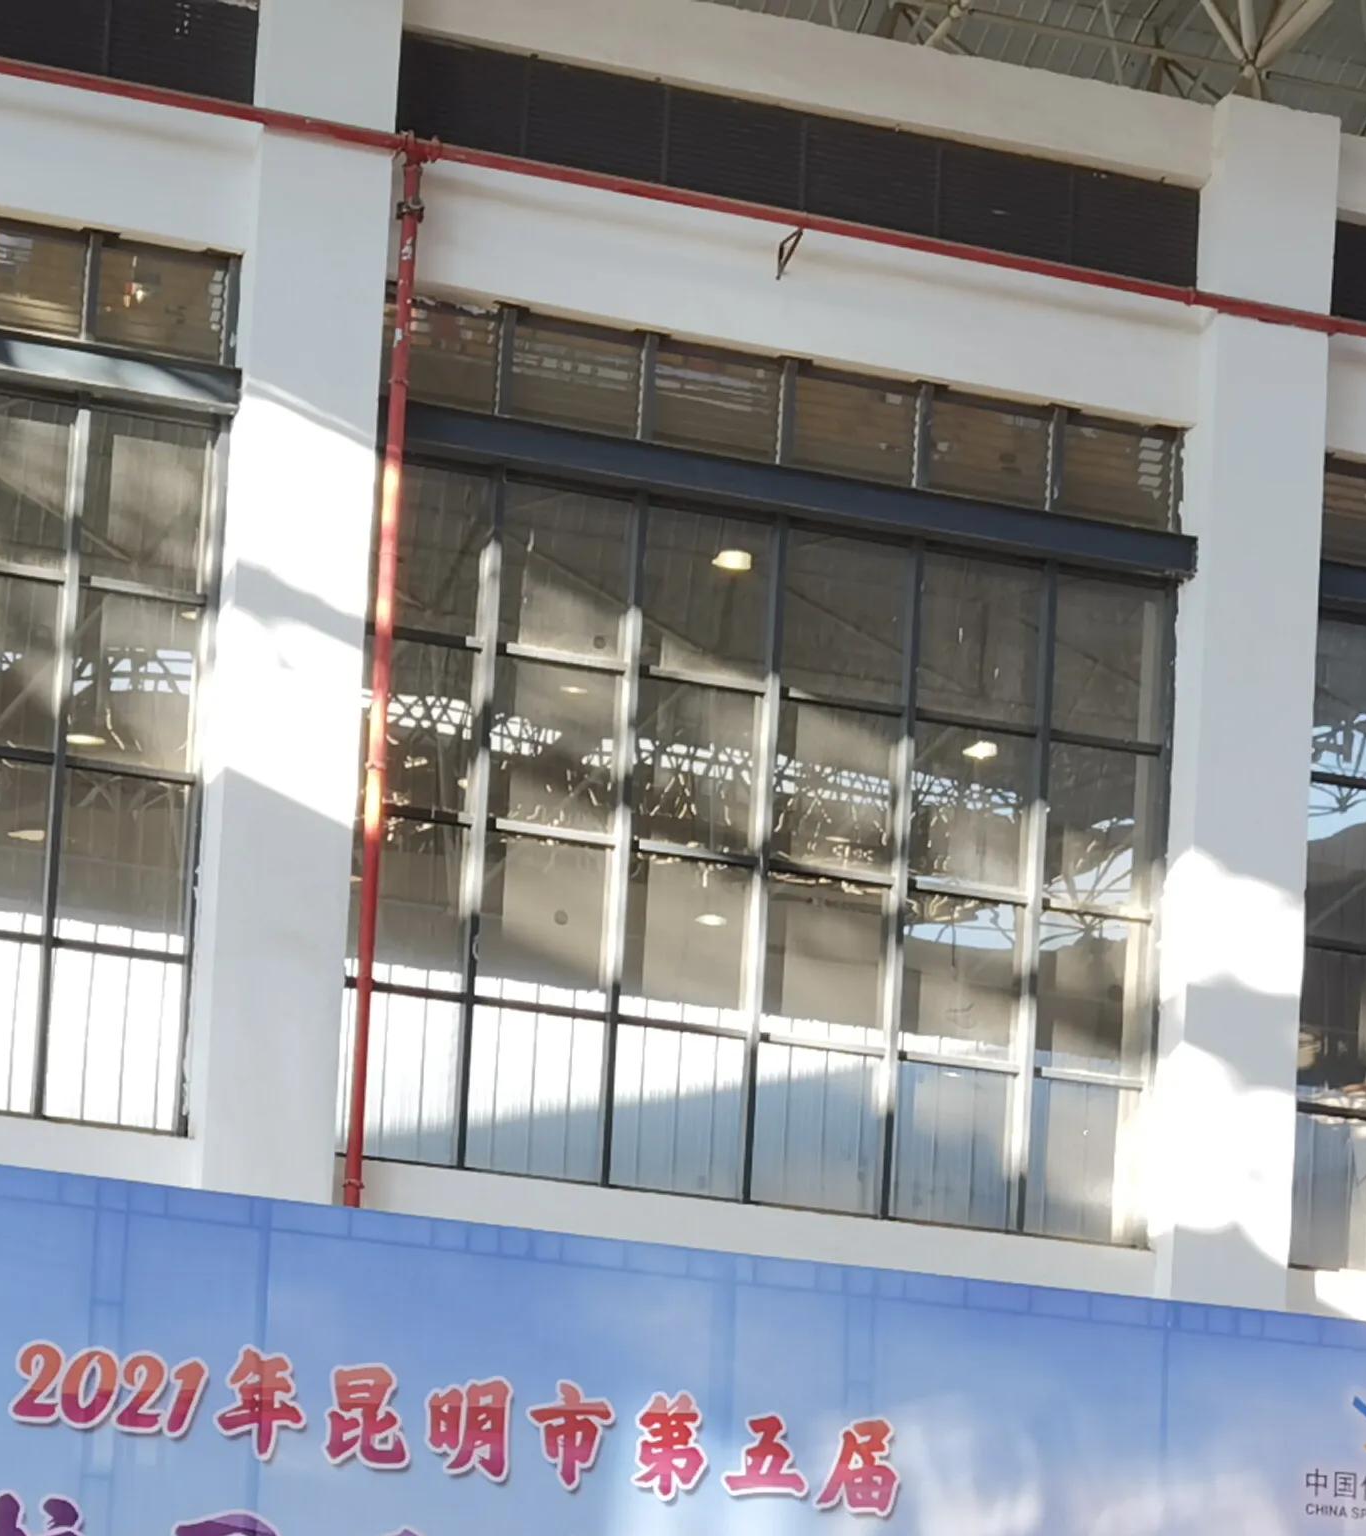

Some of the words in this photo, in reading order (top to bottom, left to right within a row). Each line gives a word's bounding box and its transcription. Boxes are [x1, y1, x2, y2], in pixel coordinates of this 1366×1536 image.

[9, 1342, 901, 1517] 2021年昆明市第五届
[1305, 1503, 1347, 1519] CHINA
